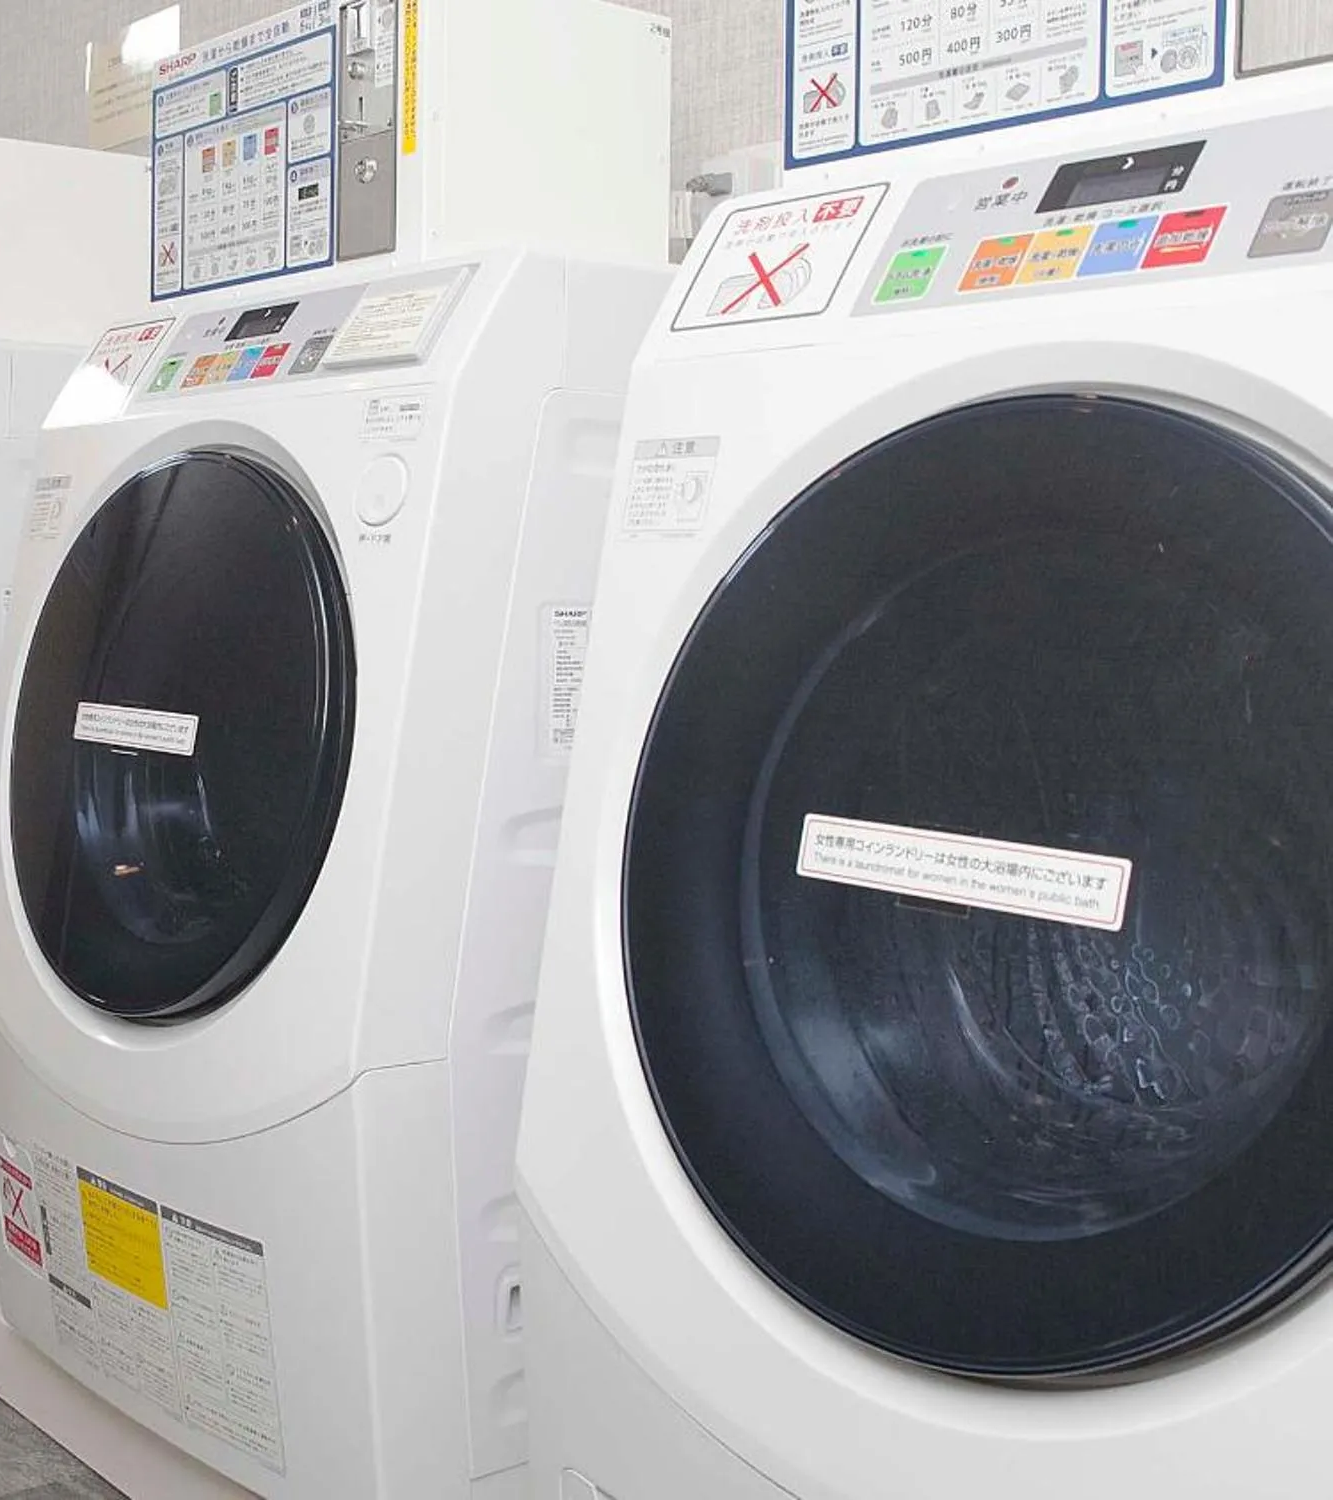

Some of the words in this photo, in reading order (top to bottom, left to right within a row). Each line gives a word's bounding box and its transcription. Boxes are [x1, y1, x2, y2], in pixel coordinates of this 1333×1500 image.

[900, 14, 933, 32] 120分
[995, 23, 1032, 44] 300円
[946, 36, 981, 54] 400円
[158, 52, 197, 76] SHARP
[898, 47, 933, 67] 500円
[974, 190, 1028, 212] 営業中
[814, 834, 1107, 890] 女性専用コインランドリーは女性の大浴場内にございます
[971, 878, 987, 890] the
[1037, 889, 1071, 906] public
